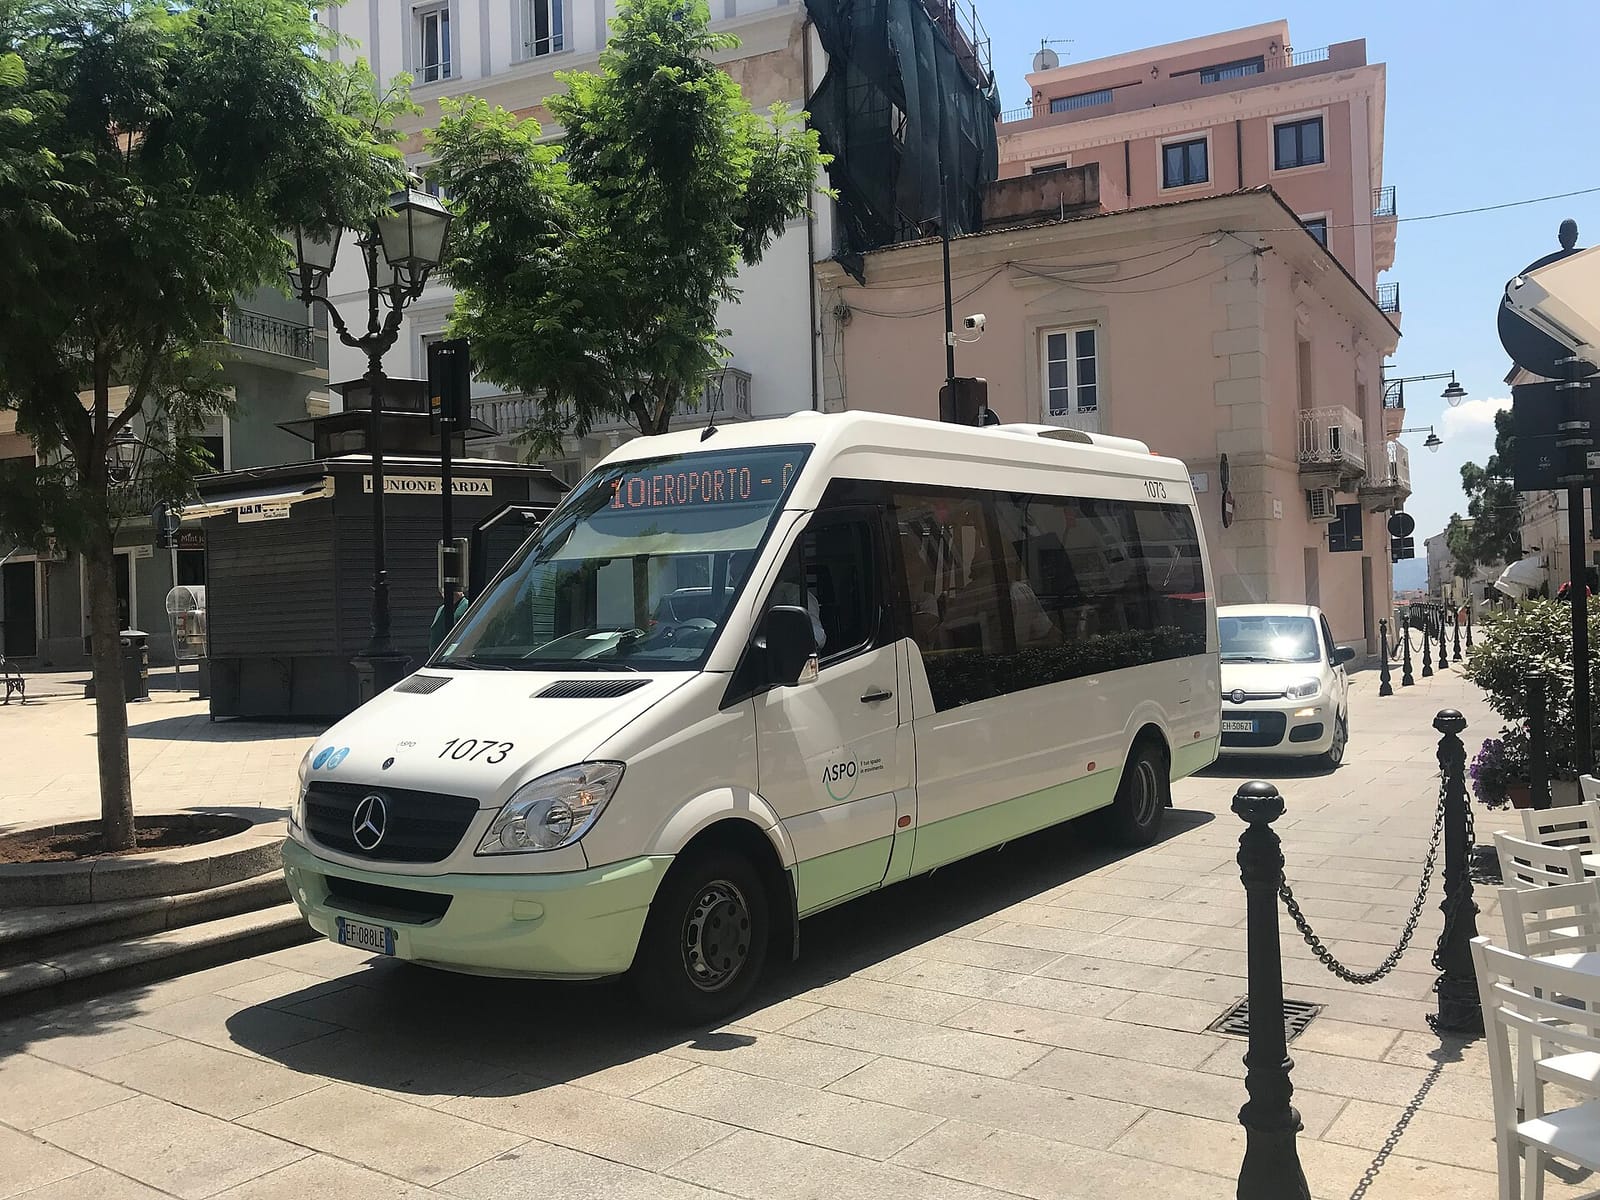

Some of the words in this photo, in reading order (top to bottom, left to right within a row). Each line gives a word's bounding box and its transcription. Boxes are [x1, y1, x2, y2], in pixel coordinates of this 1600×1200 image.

[1144, 480, 1167, 499] 1073
[438, 738, 514, 764] 1073
[822, 761, 857, 783] ASPO
